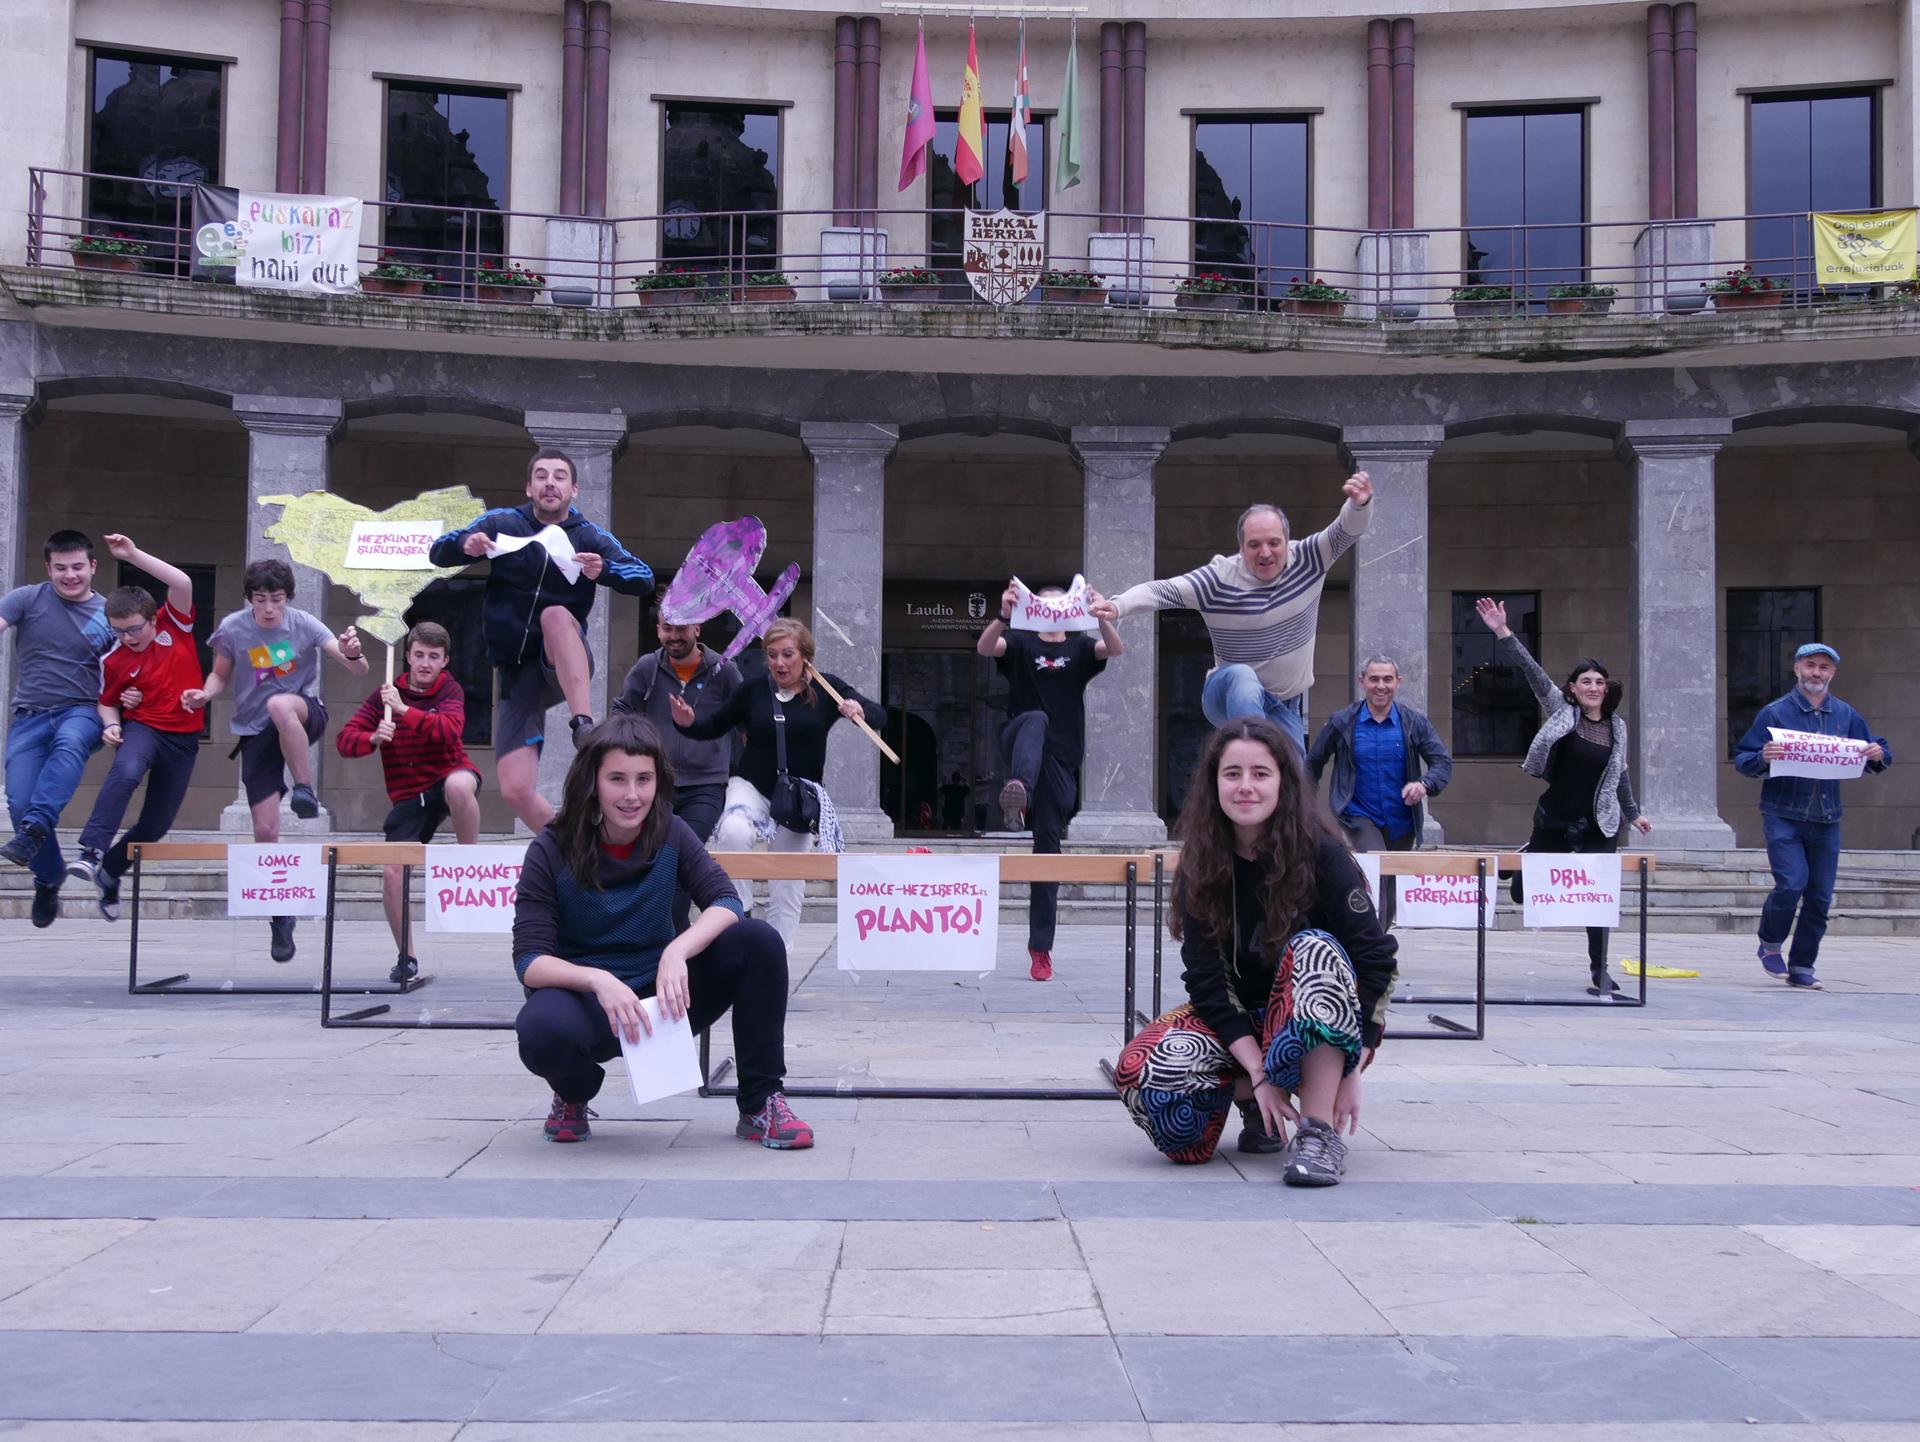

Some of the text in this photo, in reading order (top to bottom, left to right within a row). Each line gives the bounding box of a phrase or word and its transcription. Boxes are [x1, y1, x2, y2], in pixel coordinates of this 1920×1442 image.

[250, 201, 353, 229] euskaraz
[971, 217, 1038, 229] EUSKAL
[281, 230, 322, 255] bizi
[251, 256, 349, 285] nahi dut
[357, 533, 435, 544] HEZKUNTZA
[907, 603, 954, 616] Laudio
[1776, 752, 1864, 766] ERRIARENTZAT!
[258, 854, 301, 867] LOMCE
[241, 886, 317, 901] HEZIBERRI
[1531, 892, 1614, 906] PISA AZTERKETA
[855, 898, 983, 941] PLANTO!
